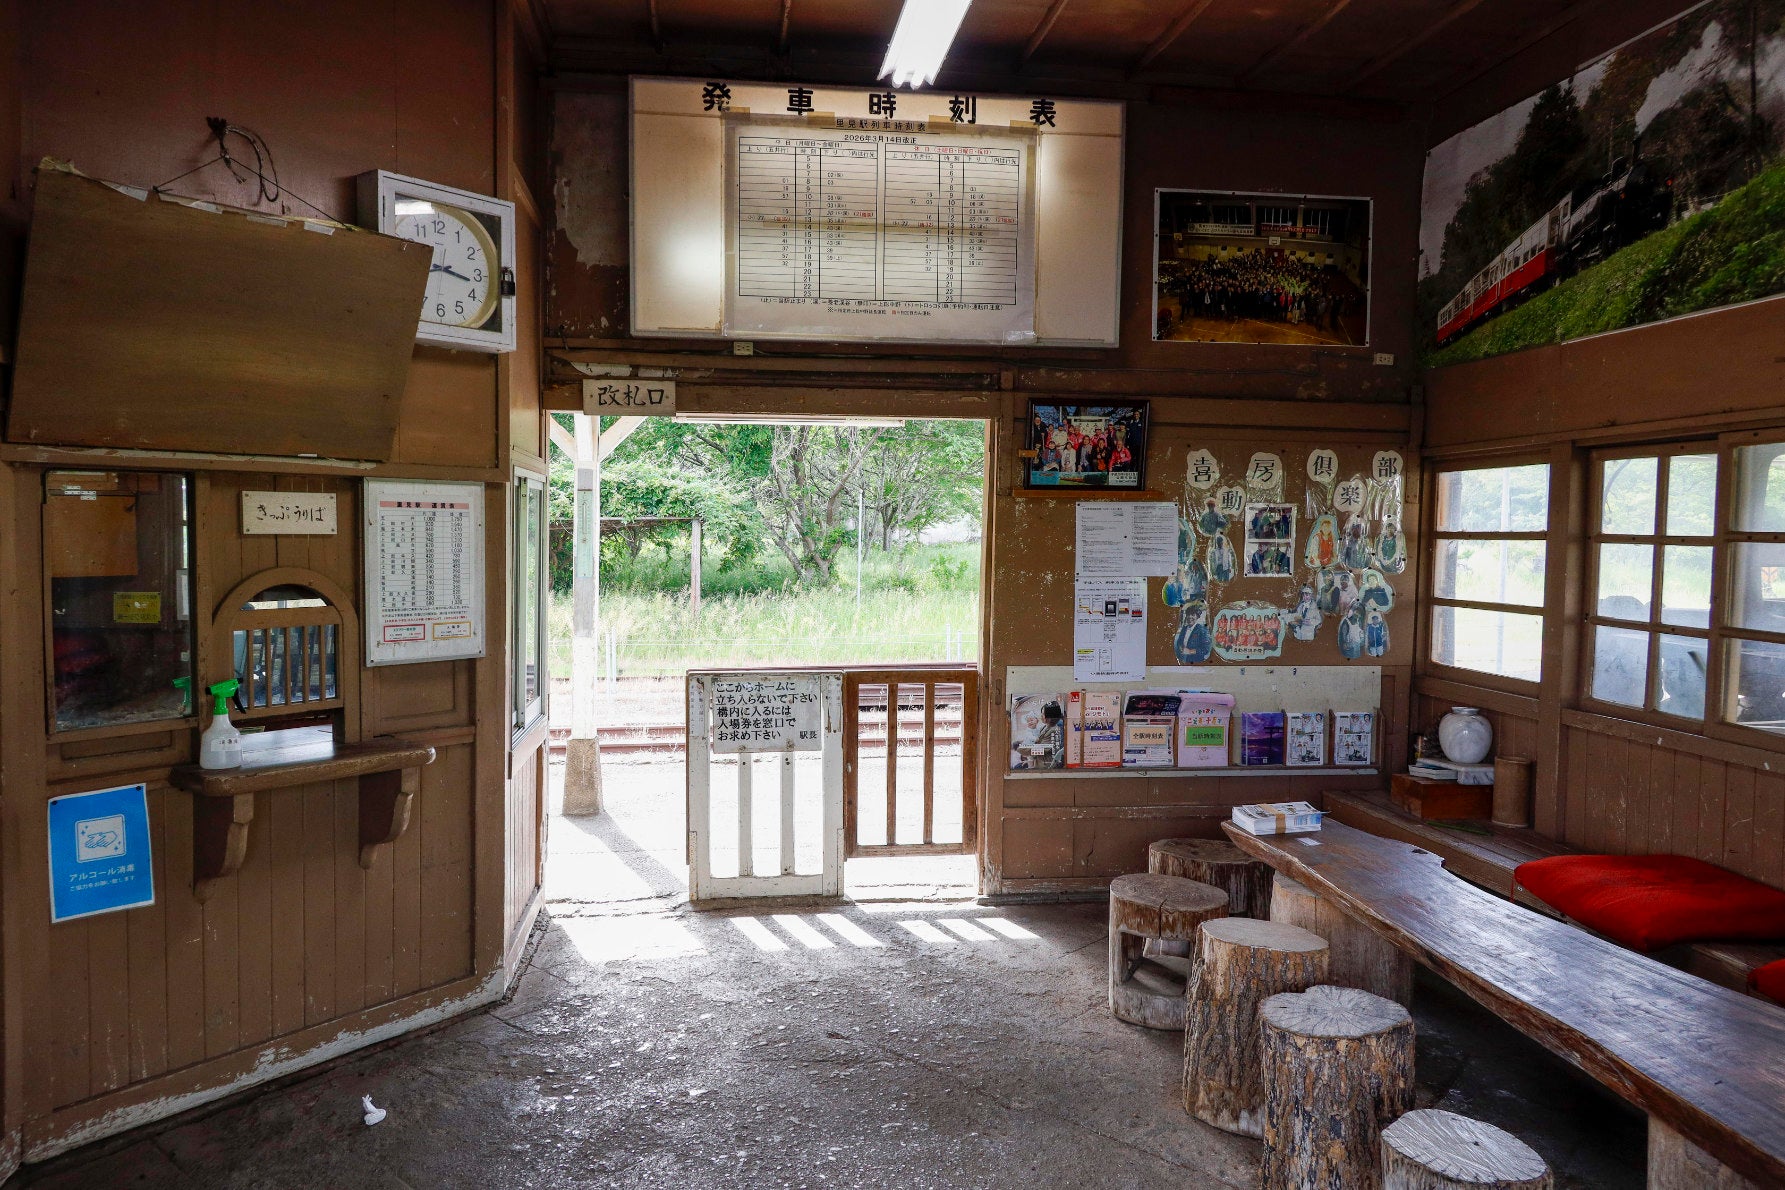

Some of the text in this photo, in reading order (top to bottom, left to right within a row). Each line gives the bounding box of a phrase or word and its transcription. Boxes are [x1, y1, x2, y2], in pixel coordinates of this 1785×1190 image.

[701, 82, 1057, 127] 発車時刻表
[835, 118, 928, 132] 里見駅列車時刻表
[844, 134, 917, 144] 2026年3月14日改正
[414, 223, 426, 238] 11
[431, 220, 445, 235] 12
[455, 230, 460, 243] 1
[467, 246, 475, 260] 2
[473, 268, 482, 282] 3
[467, 288, 477, 301] 4
[436, 303, 445, 317] 6
[454, 300, 464, 314] 5
[597, 384, 665, 406] 改札口
[256, 504, 326, 523] きっぷうりば
[715, 693, 818, 705] 立ち入らないで下さい
[717, 705, 792, 717] 構内に入るには
[717, 718, 797, 730] 入場券を窓口で
[718, 730, 781, 741] お求め下さい
[69, 863, 135, 882] アルコール消毒
